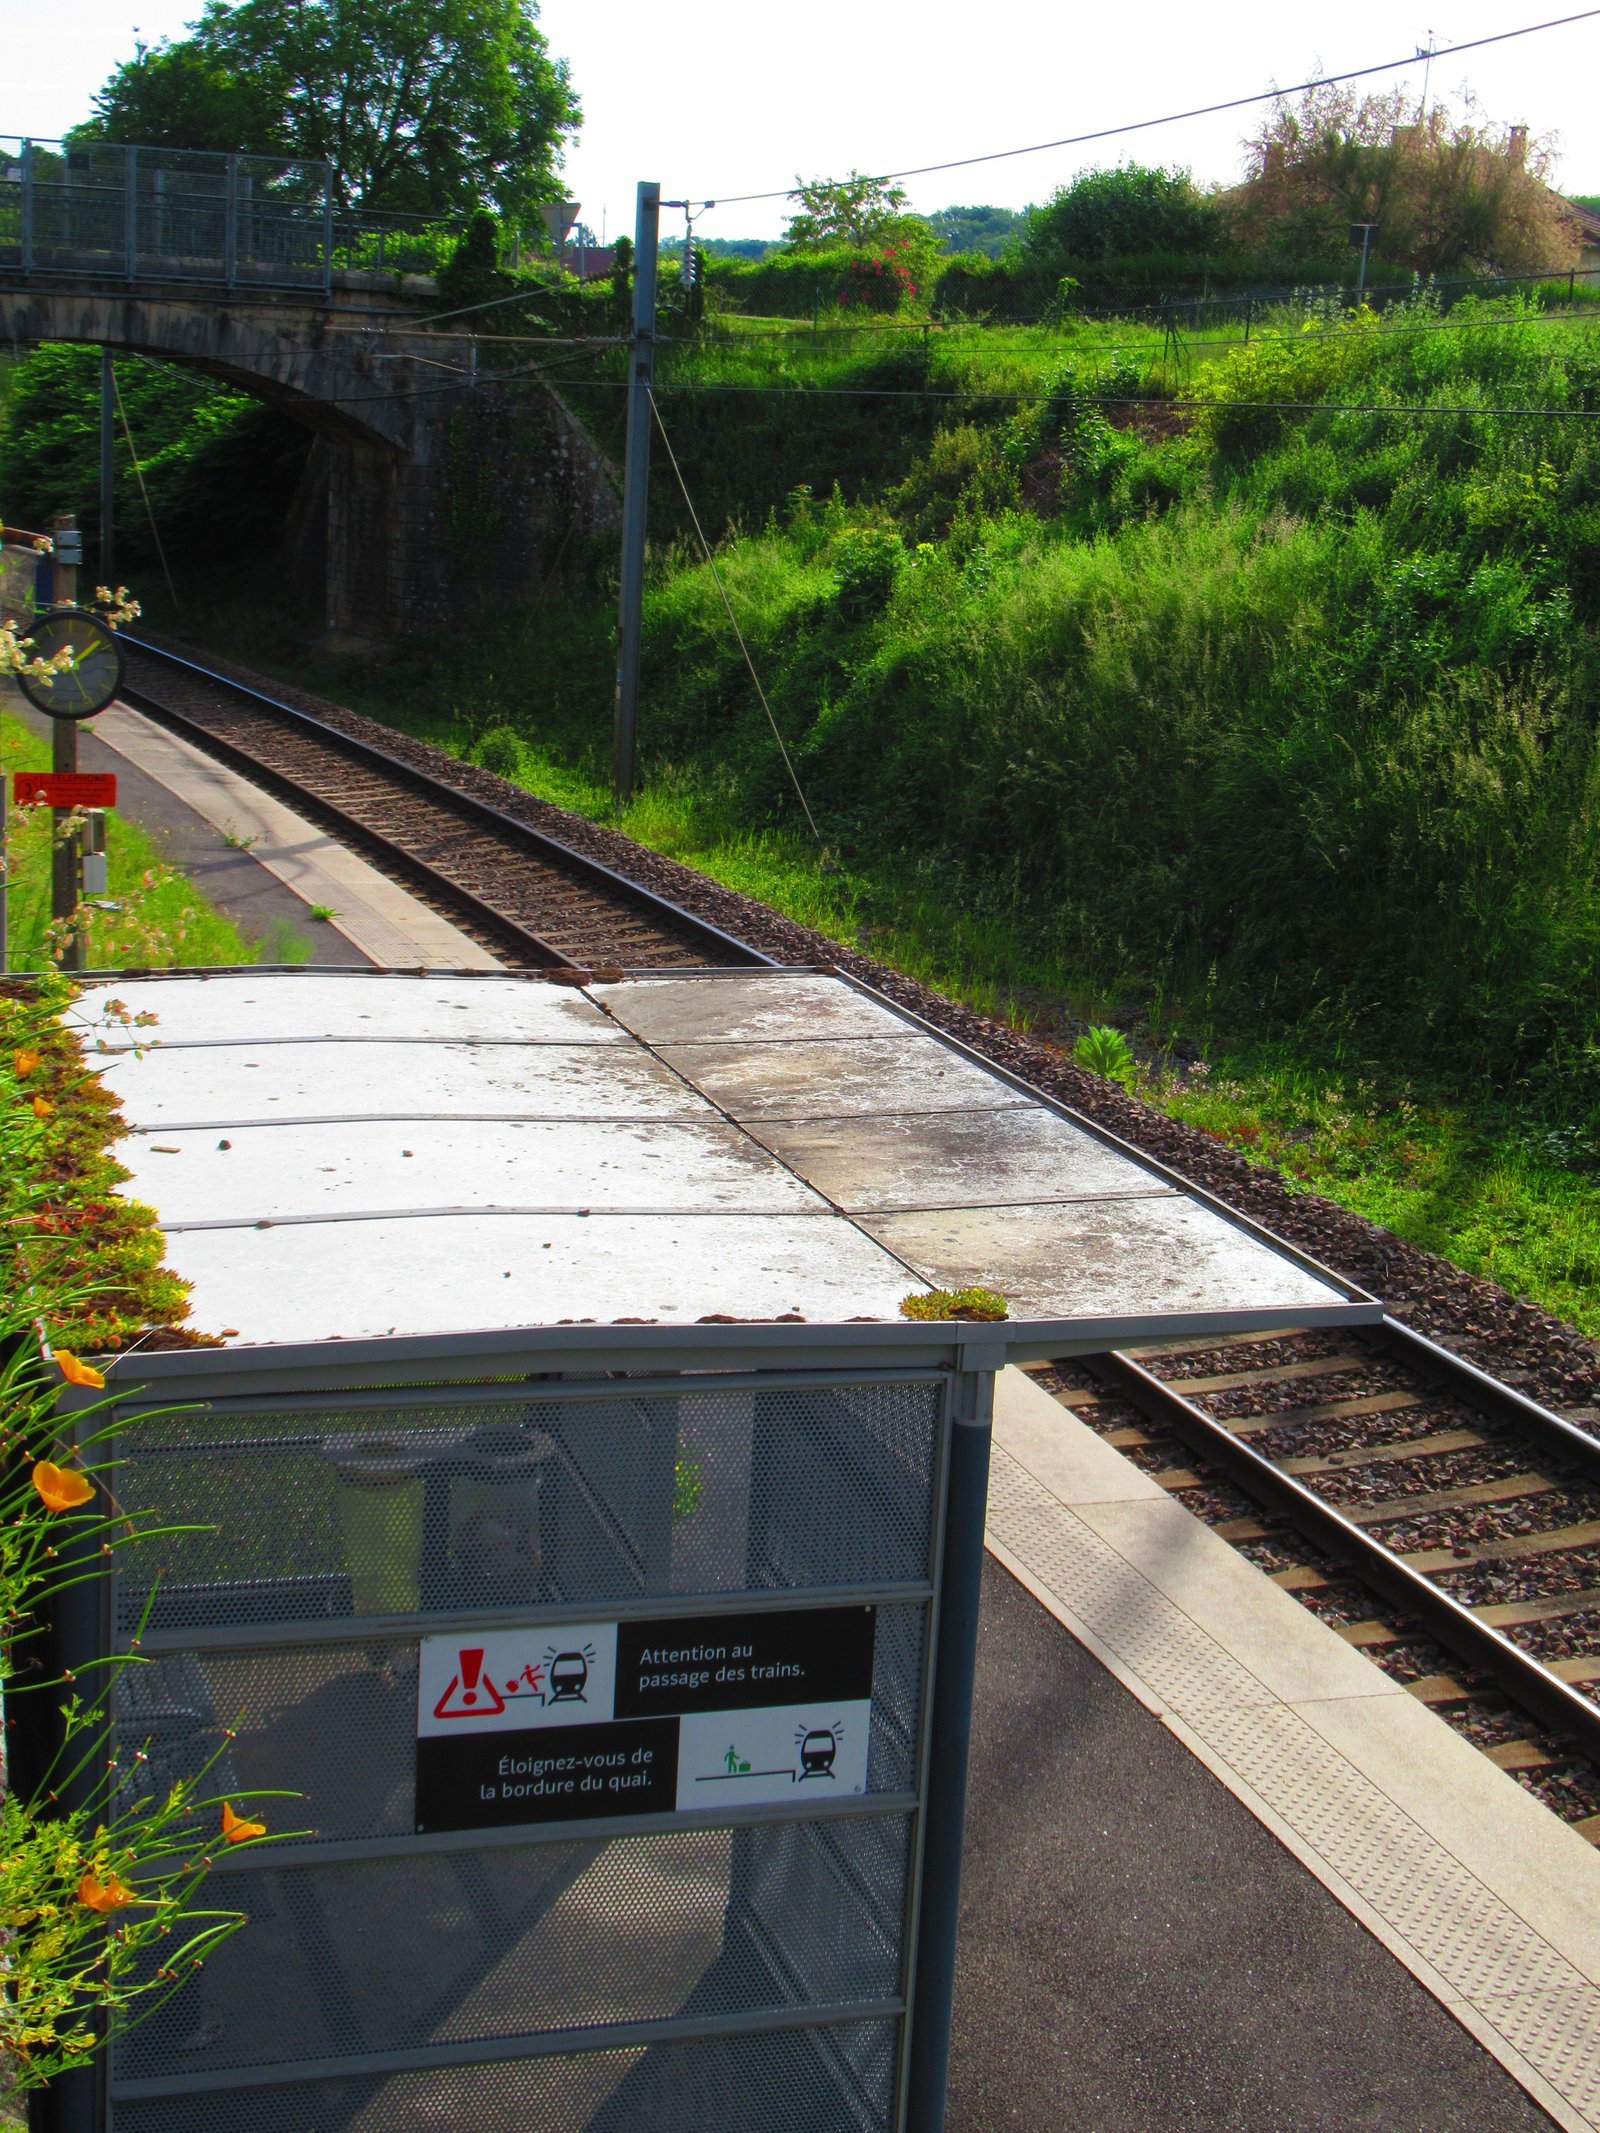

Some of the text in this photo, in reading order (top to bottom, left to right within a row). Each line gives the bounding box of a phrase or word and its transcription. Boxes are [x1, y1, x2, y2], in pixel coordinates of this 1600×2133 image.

[639, 1645, 754, 1665] Attention au
[638, 1662, 806, 1693] passage des trains.
[498, 1748, 654, 1776] Éloignez-vous de
[480, 1770, 653, 1800] la bordure du quai.
